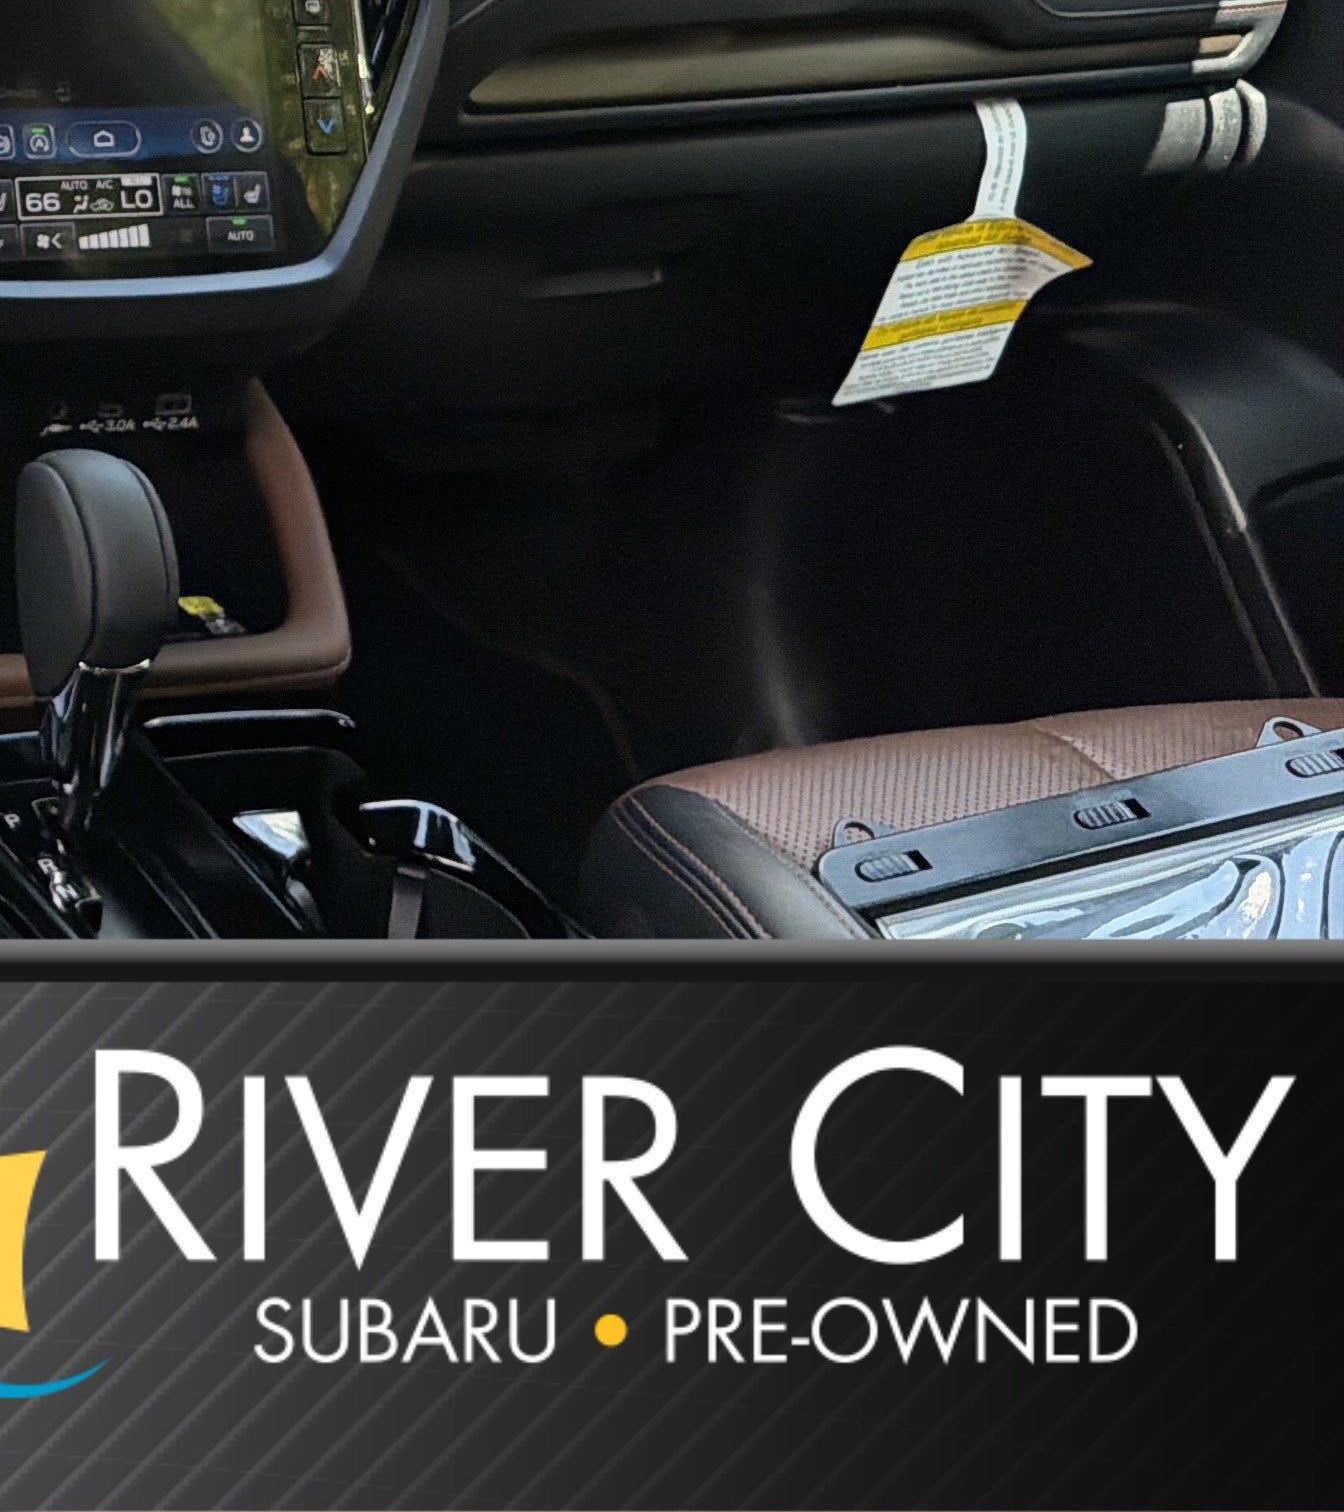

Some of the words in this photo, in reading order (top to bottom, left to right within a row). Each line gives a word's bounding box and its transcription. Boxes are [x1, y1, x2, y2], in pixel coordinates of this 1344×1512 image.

[61, 180, 88, 190] AUTO
[95, 180, 113, 190] A/C
[25, 192, 61, 213] 66
[120, 189, 153, 209] LO
[173, 198, 195, 209] ALL
[227, 230, 254, 242] AUTO
